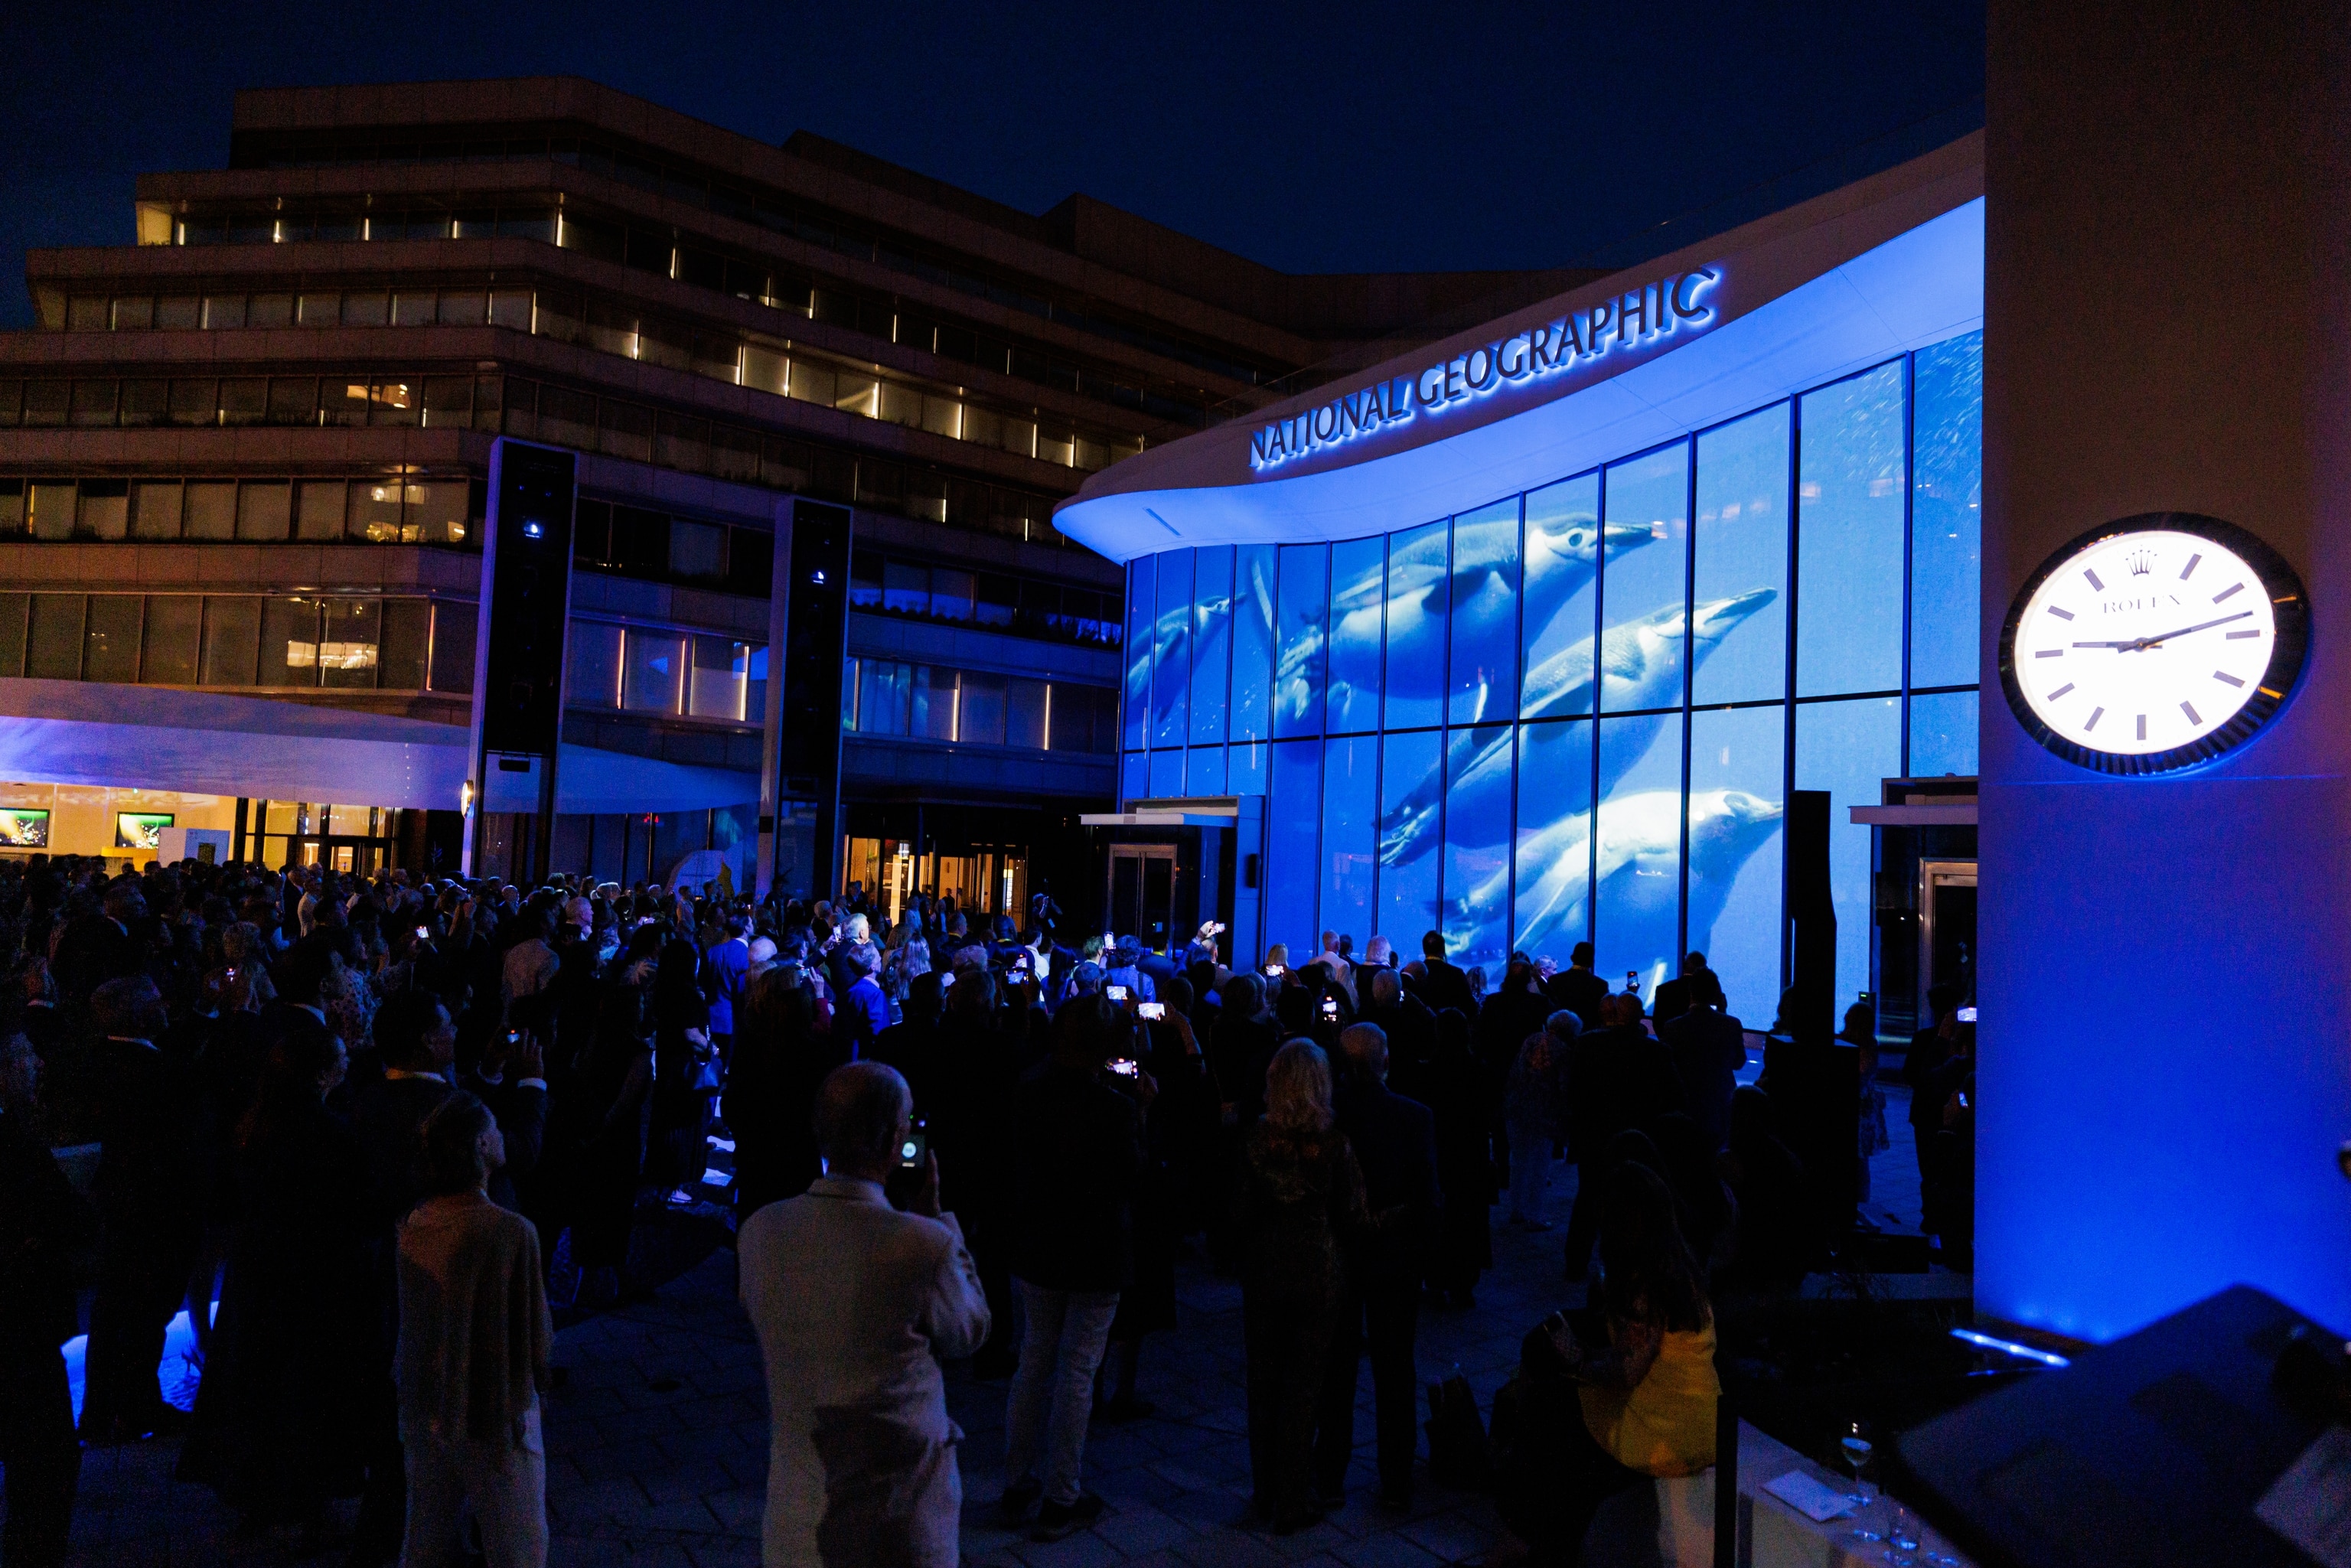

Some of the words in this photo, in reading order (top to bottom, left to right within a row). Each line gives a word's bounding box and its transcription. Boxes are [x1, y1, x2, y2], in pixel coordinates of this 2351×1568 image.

[1250, 381, 1410, 464] NATIONAL
[1415, 266, 1716, 406] GEOGRAPHIC
[2103, 594, 2181, 614] ROLEX
